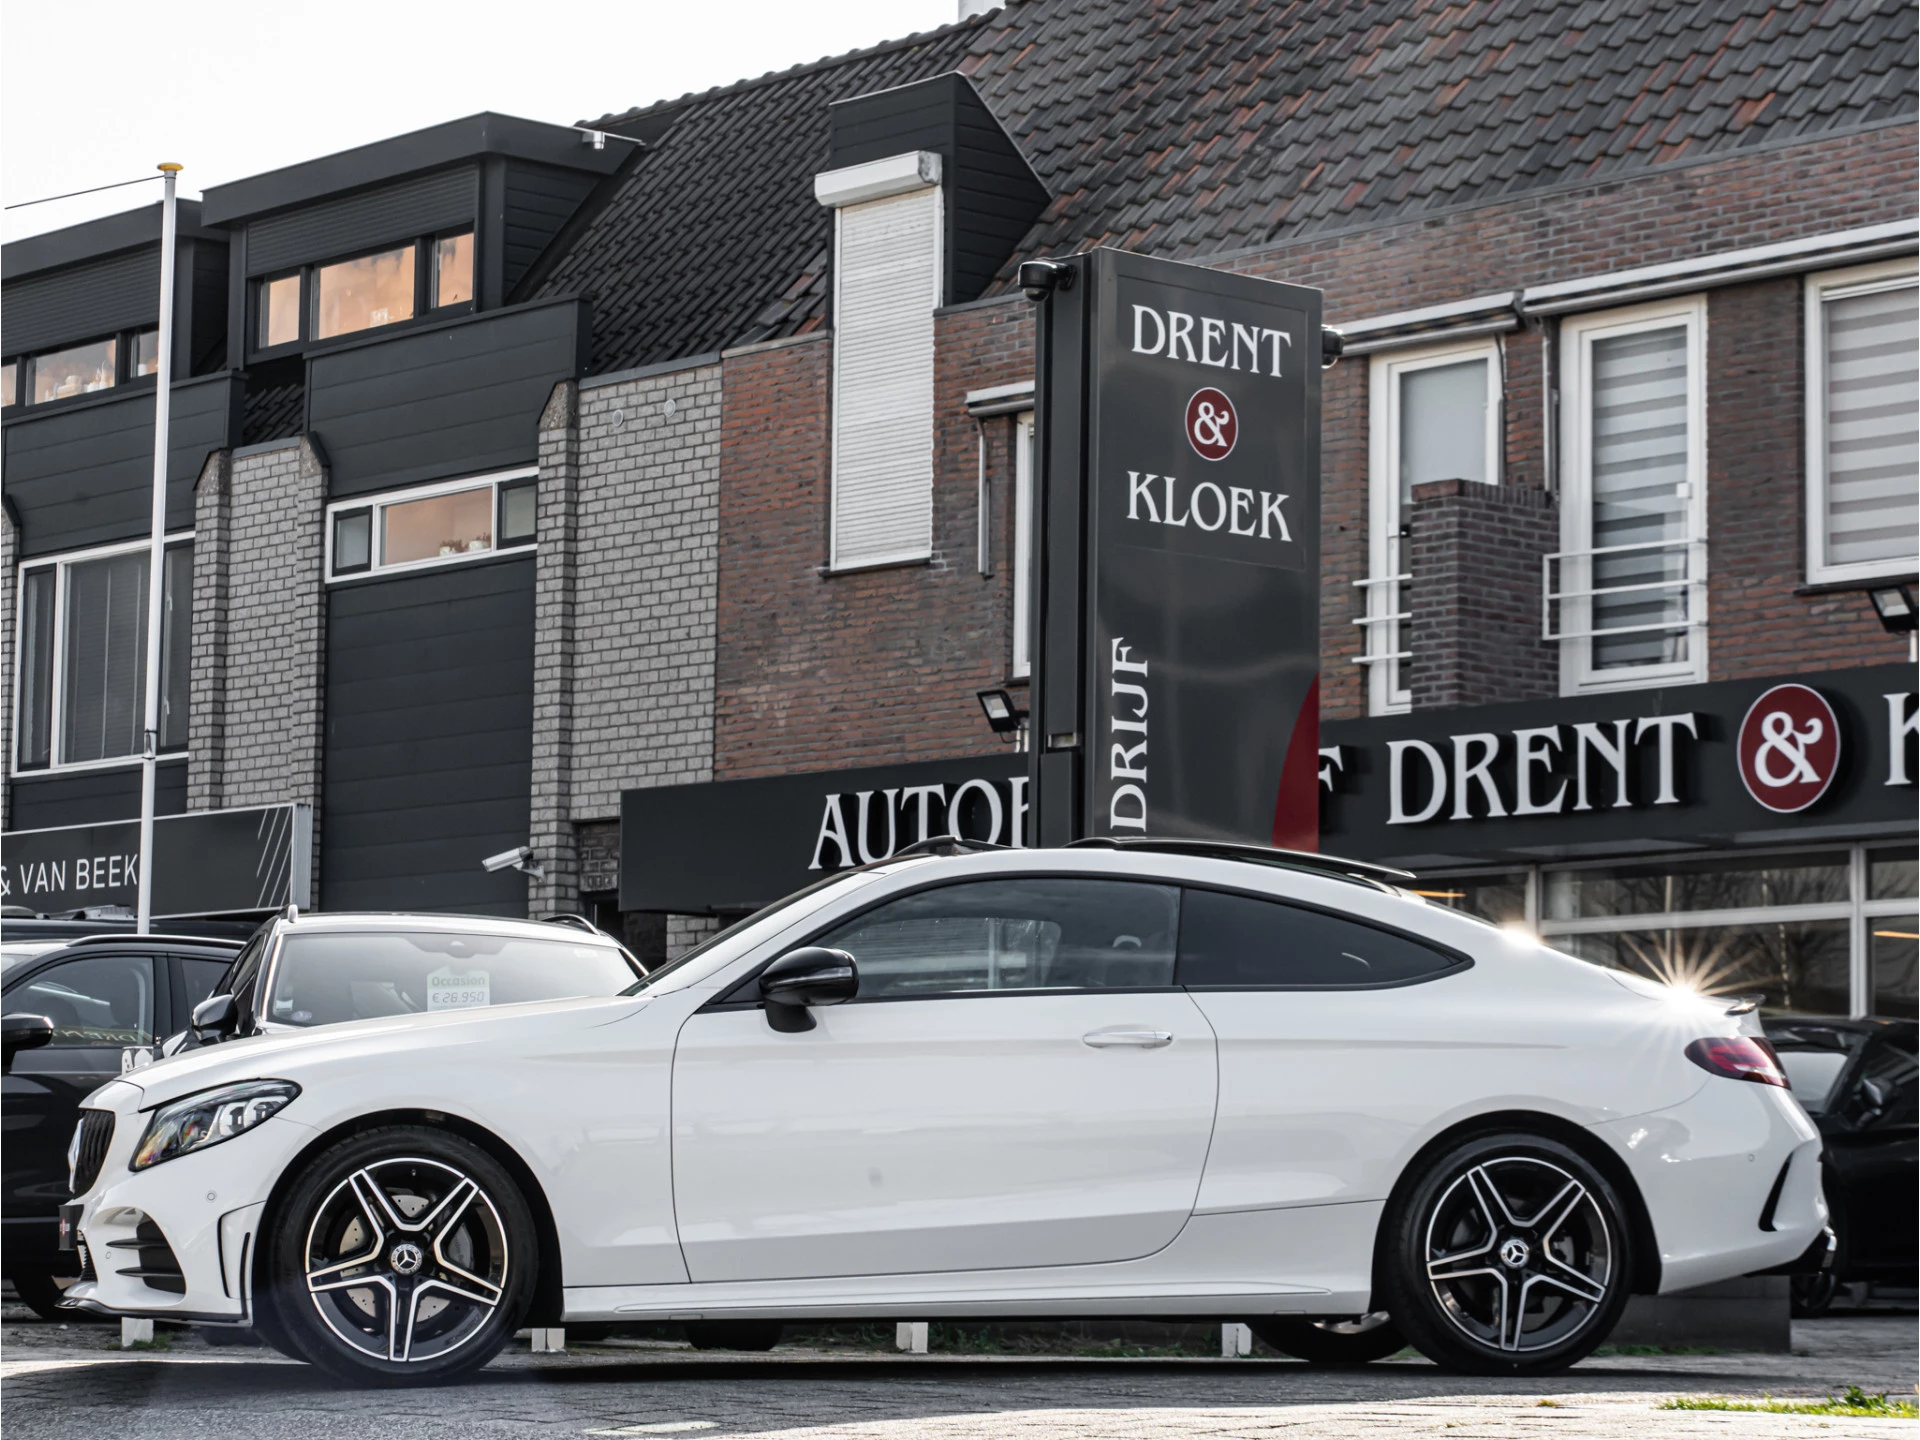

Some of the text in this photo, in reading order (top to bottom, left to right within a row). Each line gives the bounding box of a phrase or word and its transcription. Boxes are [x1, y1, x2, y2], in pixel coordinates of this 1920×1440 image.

[1131, 304, 1292, 378] DRENT
[1193, 401, 1230, 447] &
[1126, 470, 1293, 543] KLOEK
[1110, 637, 1149, 840] DRIJF
[1385, 711, 1699, 825] DRENT
[1754, 711, 1823, 788] &
[20, 860, 66, 894] VAN
[75, 853, 138, 890] BEEK
[431, 976, 485, 987] Occasion
